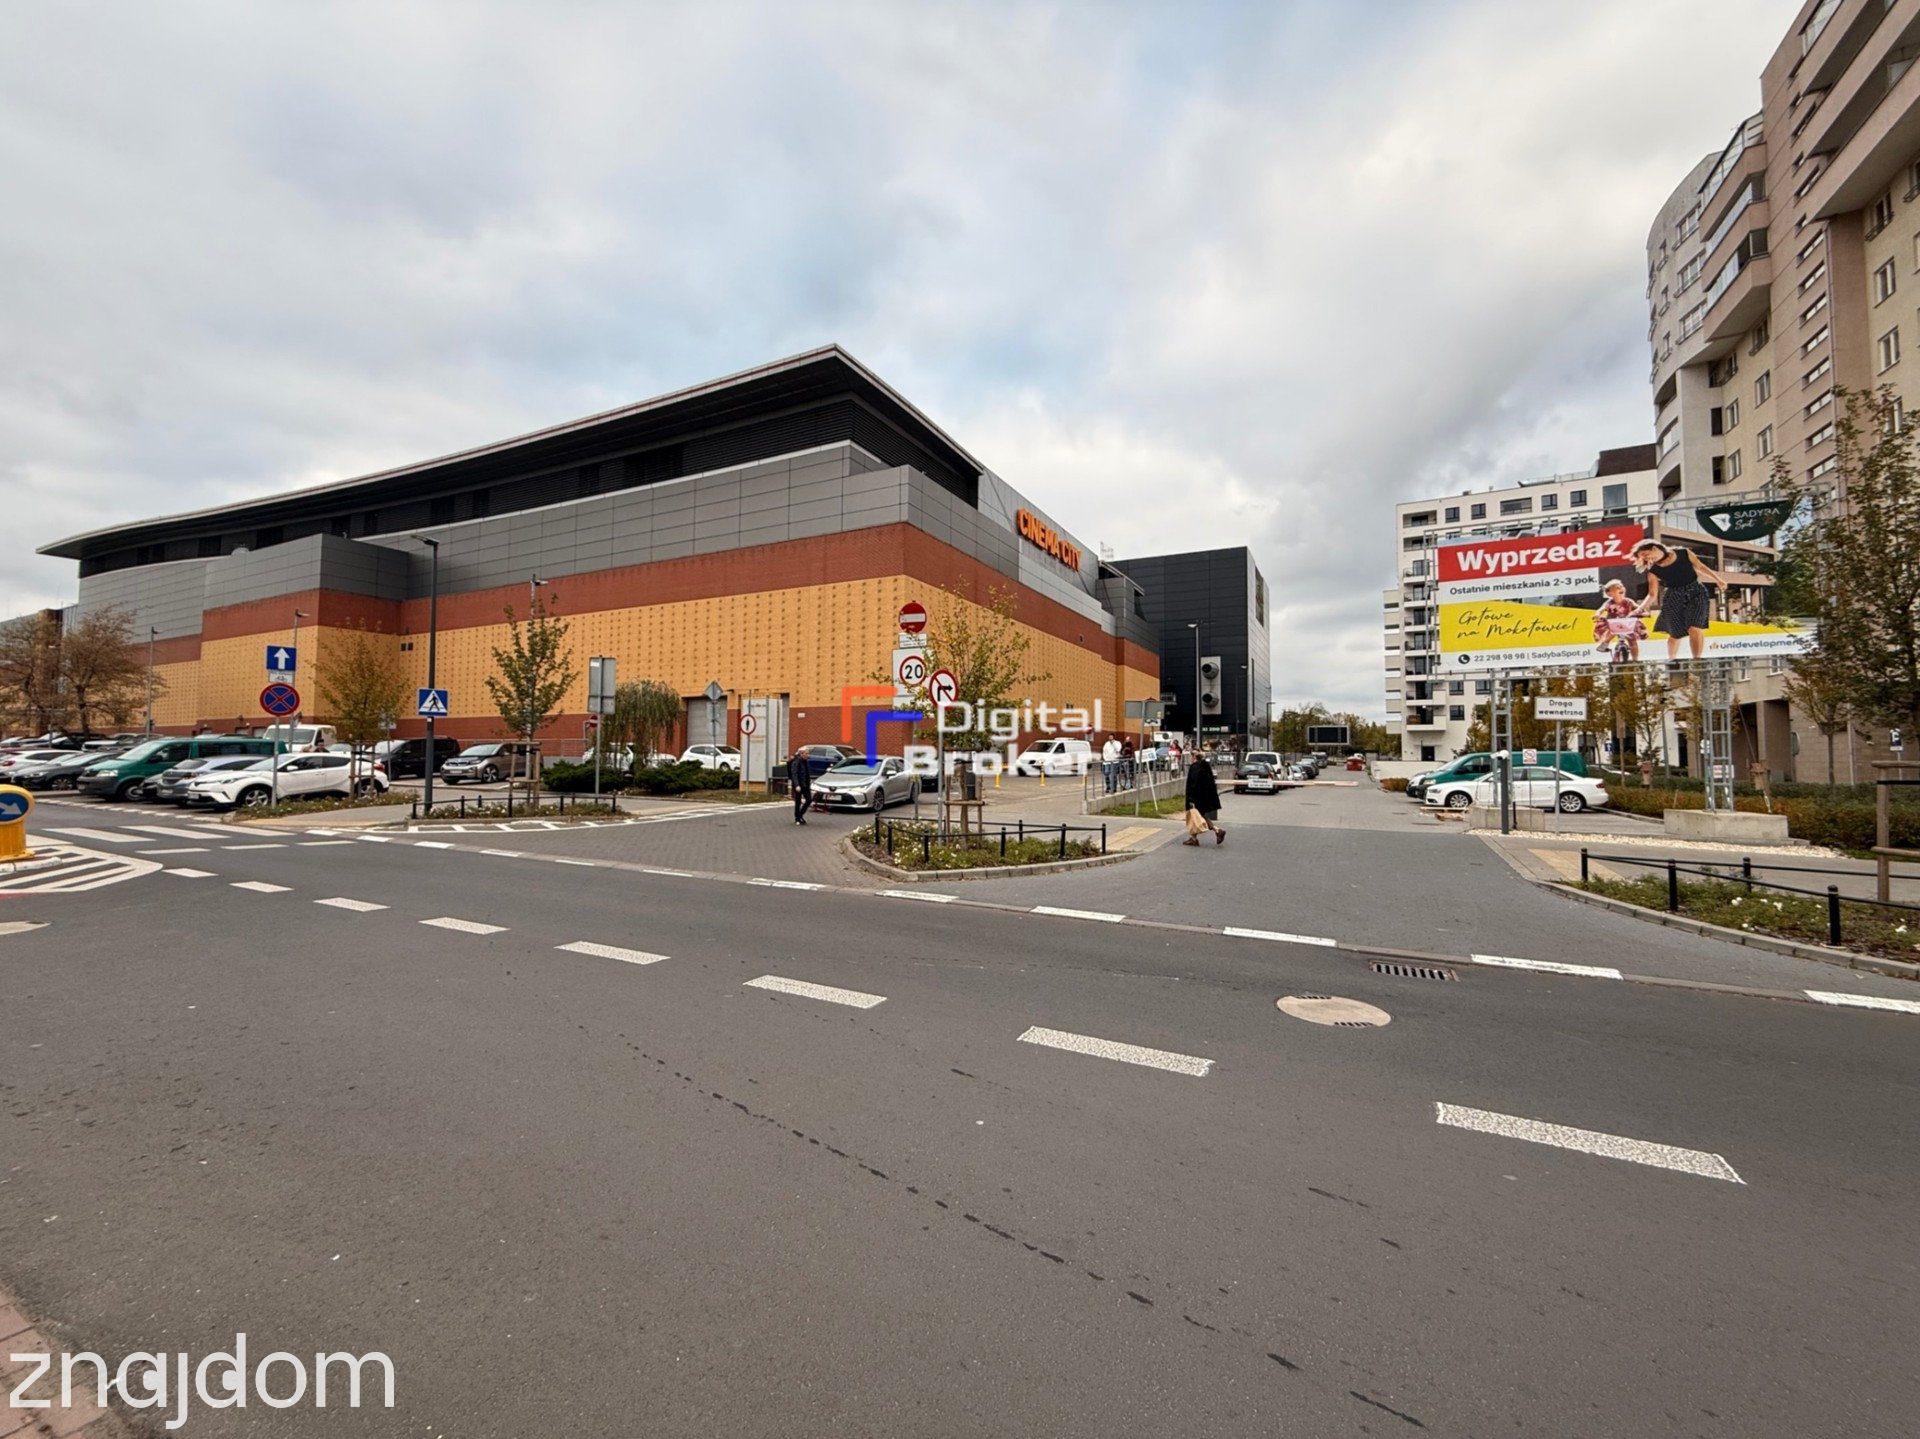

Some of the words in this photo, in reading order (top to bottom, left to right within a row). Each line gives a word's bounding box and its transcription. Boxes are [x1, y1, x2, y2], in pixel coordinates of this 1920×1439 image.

[1016, 507, 1060, 558] CINEMA
[1059, 540, 1083, 572] CITY
[1456, 533, 1622, 575] Wyprzedaż
[1449, 584, 1491, 596] Ostatnie
[1492, 579, 1551, 591] mieszkania
[1553, 577, 1572, 587] 2-3
[1574, 574, 1598, 588] pok.
[1458, 606, 1514, 626] Gotowe
[1457, 629, 1480, 639] na
[1485, 617, 1577, 639] Mokotowie!
[1473, 655, 1486, 663] 22
[1486, 653, 1501, 662] 298
[1502, 652, 1514, 661] 98
[1531, 649, 1591, 660] SadybaSpot.pl
[905, 664, 924, 679] 20
[1549, 699, 1573, 707] Droga
